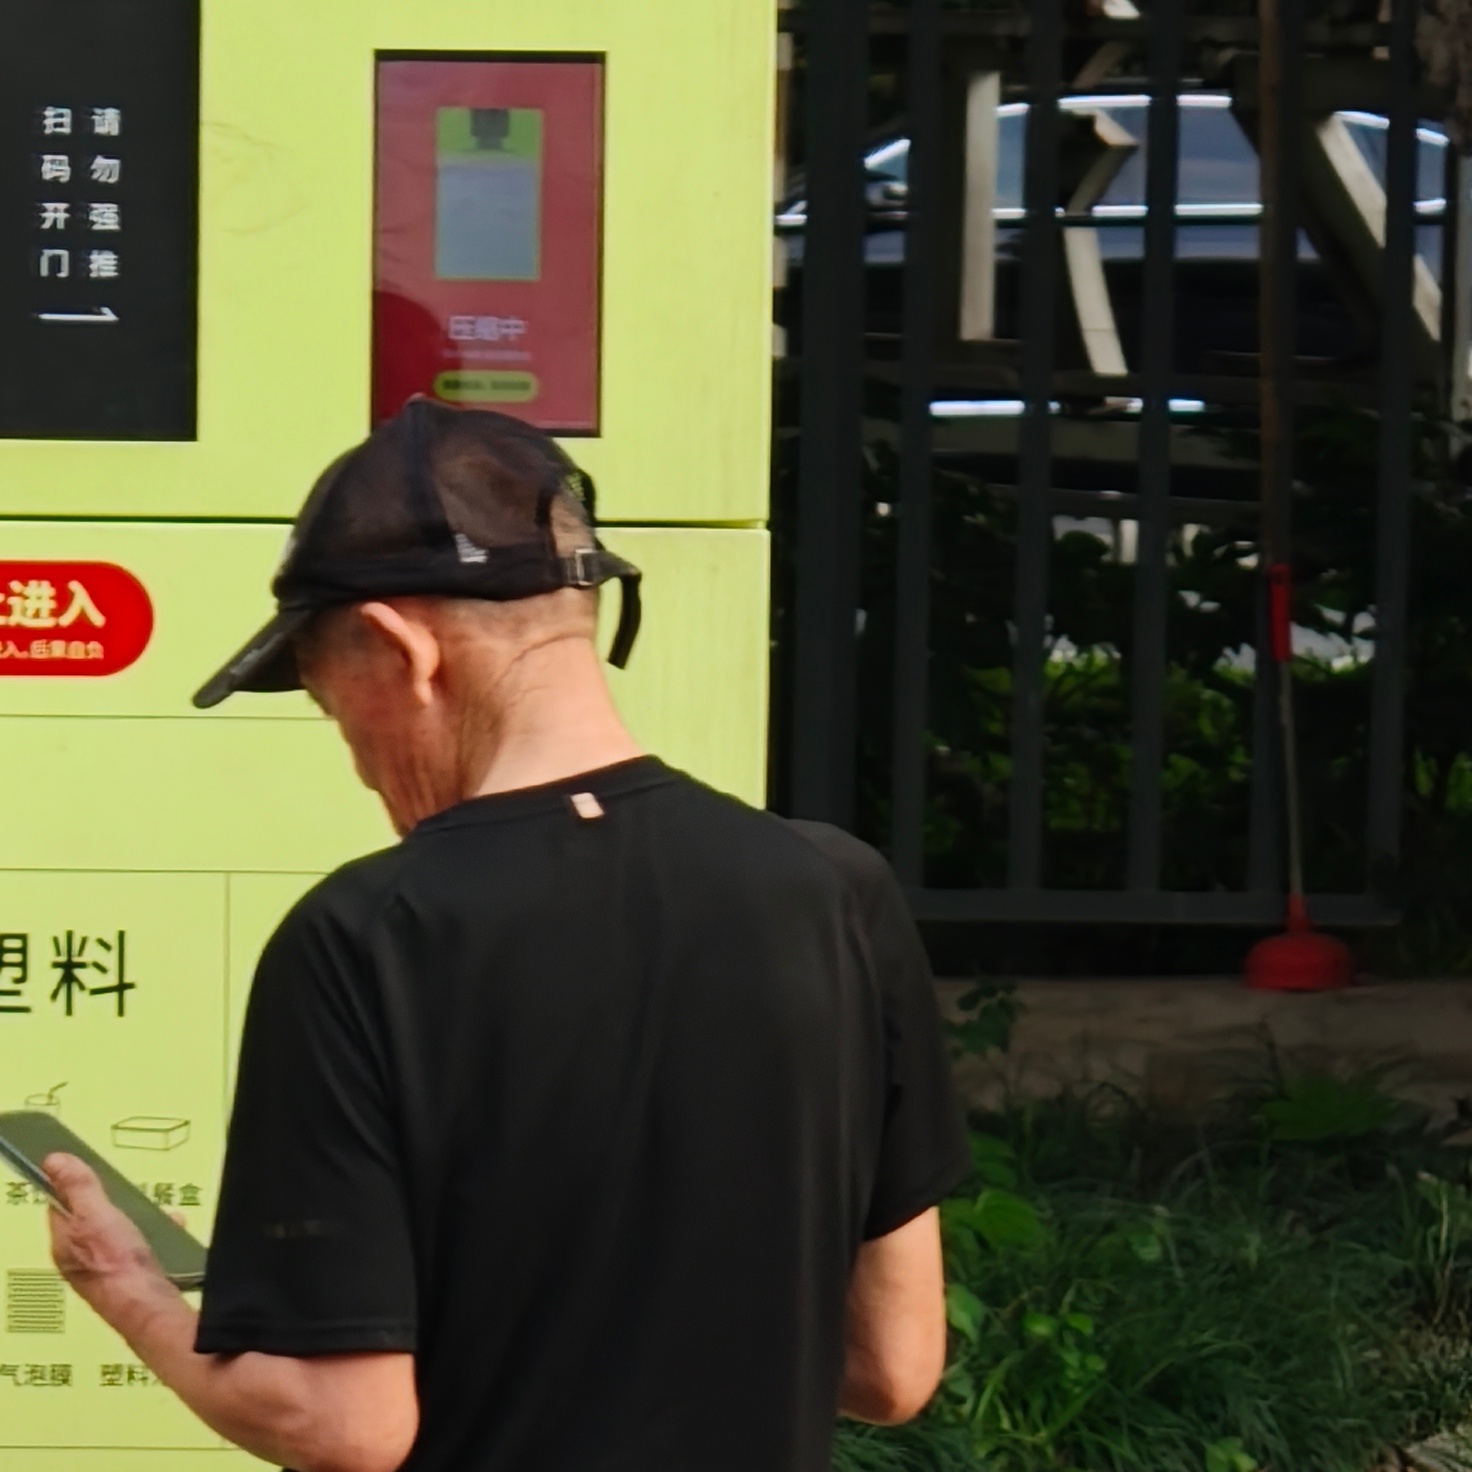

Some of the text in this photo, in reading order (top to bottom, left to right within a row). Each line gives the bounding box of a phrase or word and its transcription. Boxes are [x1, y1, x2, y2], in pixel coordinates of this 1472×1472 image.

[40, 107, 71, 277] 扫码开门
[89, 108, 120, 277] 请勿强推
[140, 1182, 203, 1207] 餐盒
[99, 1363, 159, 1387] 塑料
